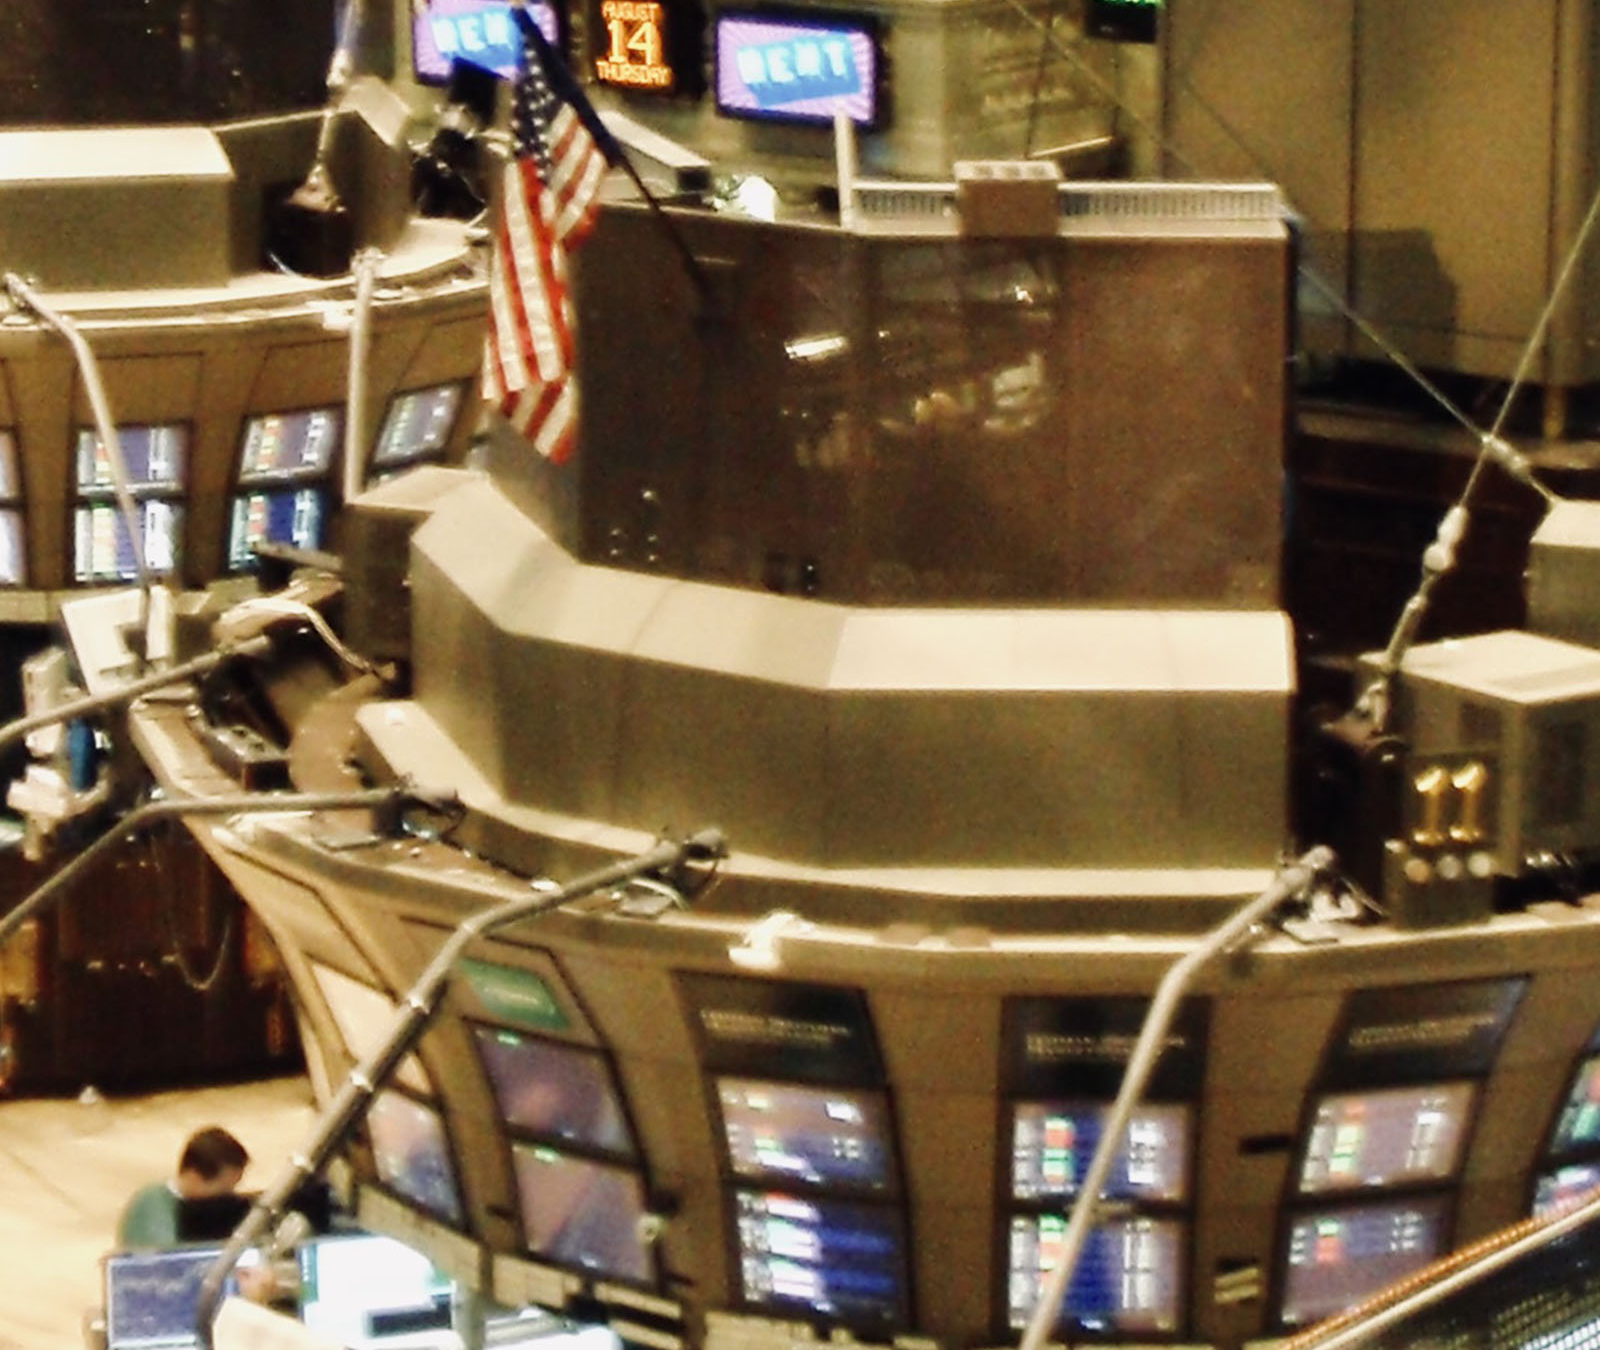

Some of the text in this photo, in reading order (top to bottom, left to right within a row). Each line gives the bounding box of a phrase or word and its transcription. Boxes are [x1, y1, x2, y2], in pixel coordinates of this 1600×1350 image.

[602, 0, 661, 21] AUGUST
[608, 19, 655, 67] 14
[596, 60, 671, 85] THURSDAY
